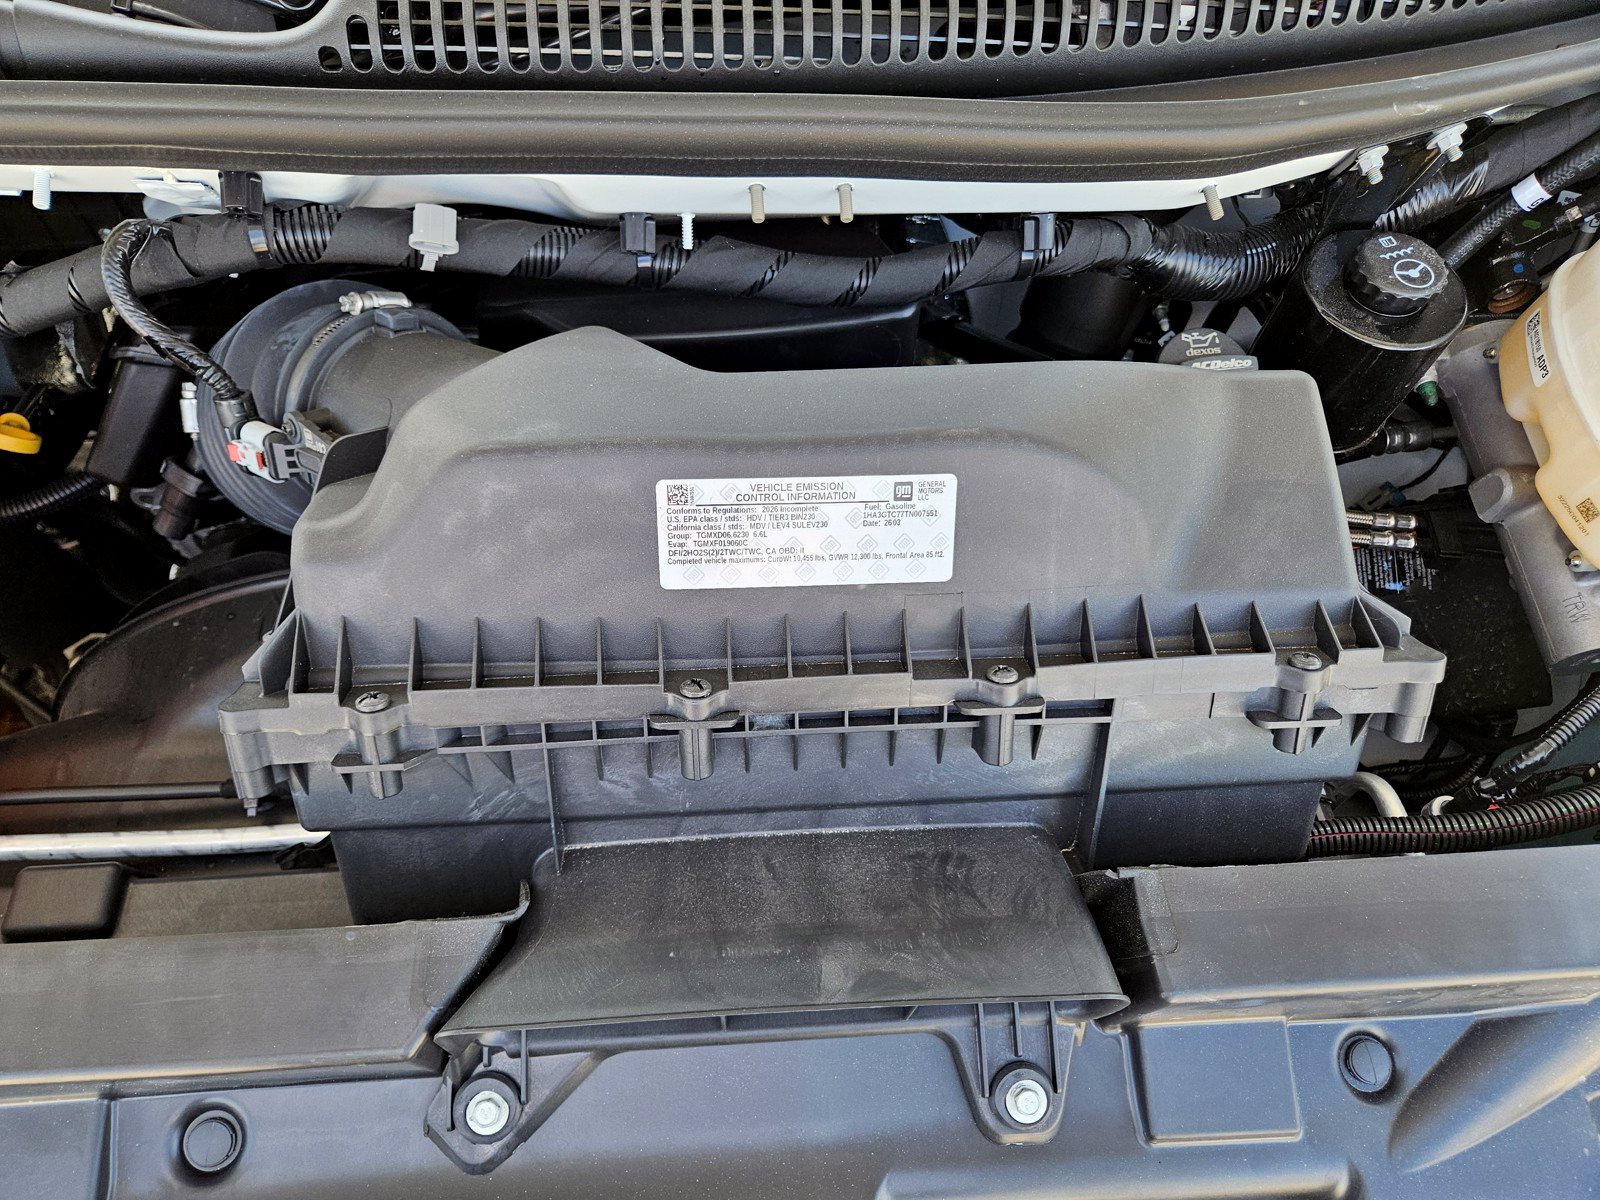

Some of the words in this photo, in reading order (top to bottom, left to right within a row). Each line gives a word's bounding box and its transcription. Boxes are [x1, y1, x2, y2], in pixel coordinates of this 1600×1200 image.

[1185, 347, 1222, 357] dexos
[1191, 358, 1253, 369] ACDelco
[1537, 354, 1550, 379] ADP3
[750, 483, 793, 492] VEHICLE
[796, 482, 844, 491] EMISSION
[918, 480, 946, 488] GENERAL
[736, 493, 785, 502] CONTROL
[787, 491, 857, 501] INFORMATION
[666, 507, 701, 515] Conforms
[712, 506, 757, 516] Regulations:
[762, 505, 779, 513] 2026
[780, 505, 819, 514] Incomplete
[864, 503, 882, 511] Fuel:
[885, 502, 916, 510] Gasoline
[683, 515, 698, 523] EPA
[699, 515, 719, 523] class
[747, 514, 762, 522] HDV
[769, 513, 789, 521] TIER3
[790, 513, 816, 521] BIN230
[862, 519, 881, 527] Date:
[667, 523, 701, 531] California
[749, 522, 766, 530] MDV
[771, 521, 790, 529] LEV4
[792, 520, 829, 529] SULEV230
[667, 532, 692, 541] Group:
[696, 531, 749, 539] TGMXD06.6230
[753, 530, 768, 538] 6.6L
[667, 540, 688, 549] Evap:
[693, 539, 748, 548] TGMXF019060C
[765, 547, 777, 555] CA
[667, 557, 702, 566] Completed
[728, 556, 766, 564] maximums:
[793, 554, 814, 563] 10,455
[828, 553, 849, 561] GVWR
[851, 553, 870, 561] 12,300
[872, 552, 884, 560] lbs,
[885, 551, 908, 559] Frontal
